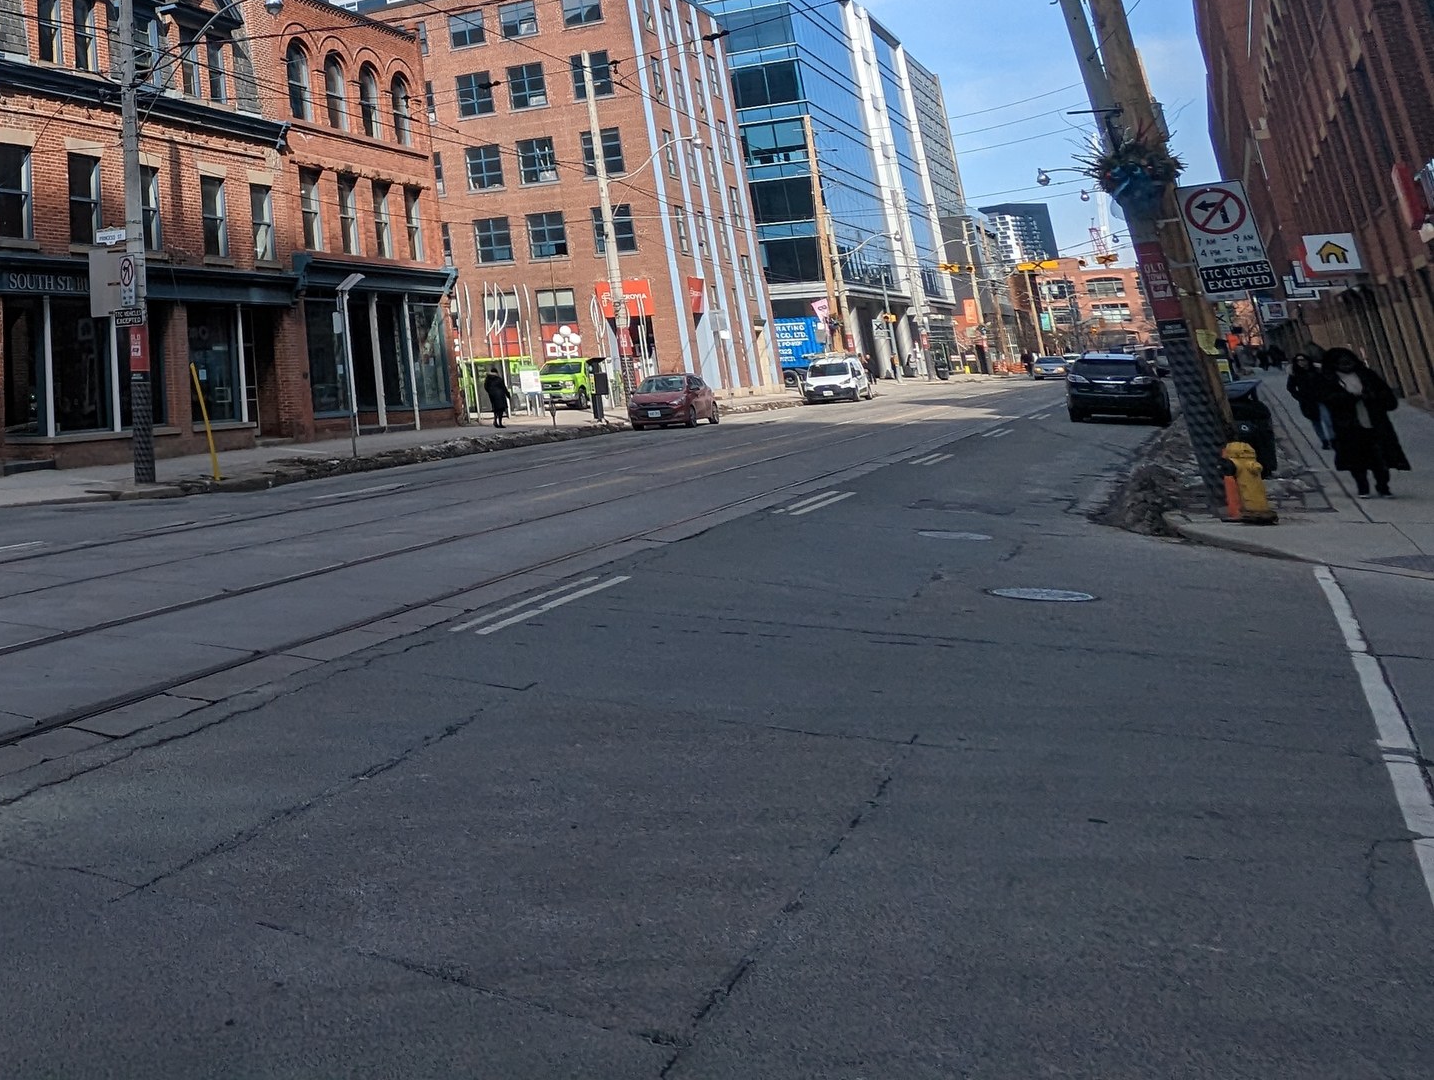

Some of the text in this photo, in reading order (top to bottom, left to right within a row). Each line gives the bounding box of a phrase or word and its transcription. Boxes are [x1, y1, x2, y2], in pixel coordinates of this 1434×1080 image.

[1195, 237, 1202, 247] 7
[1232, 233, 1240, 242] 9
[1200, 249, 1208, 257] 4
[1209, 249, 1221, 257] PM
[1236, 245, 1244, 254] 6
[1201, 263, 1271, 279] TTC VEHICLES
[9, 273, 55, 291] SOUTH
[56, 275, 74, 291] ST.
[1208, 275, 1271, 290] EXCEPTED
